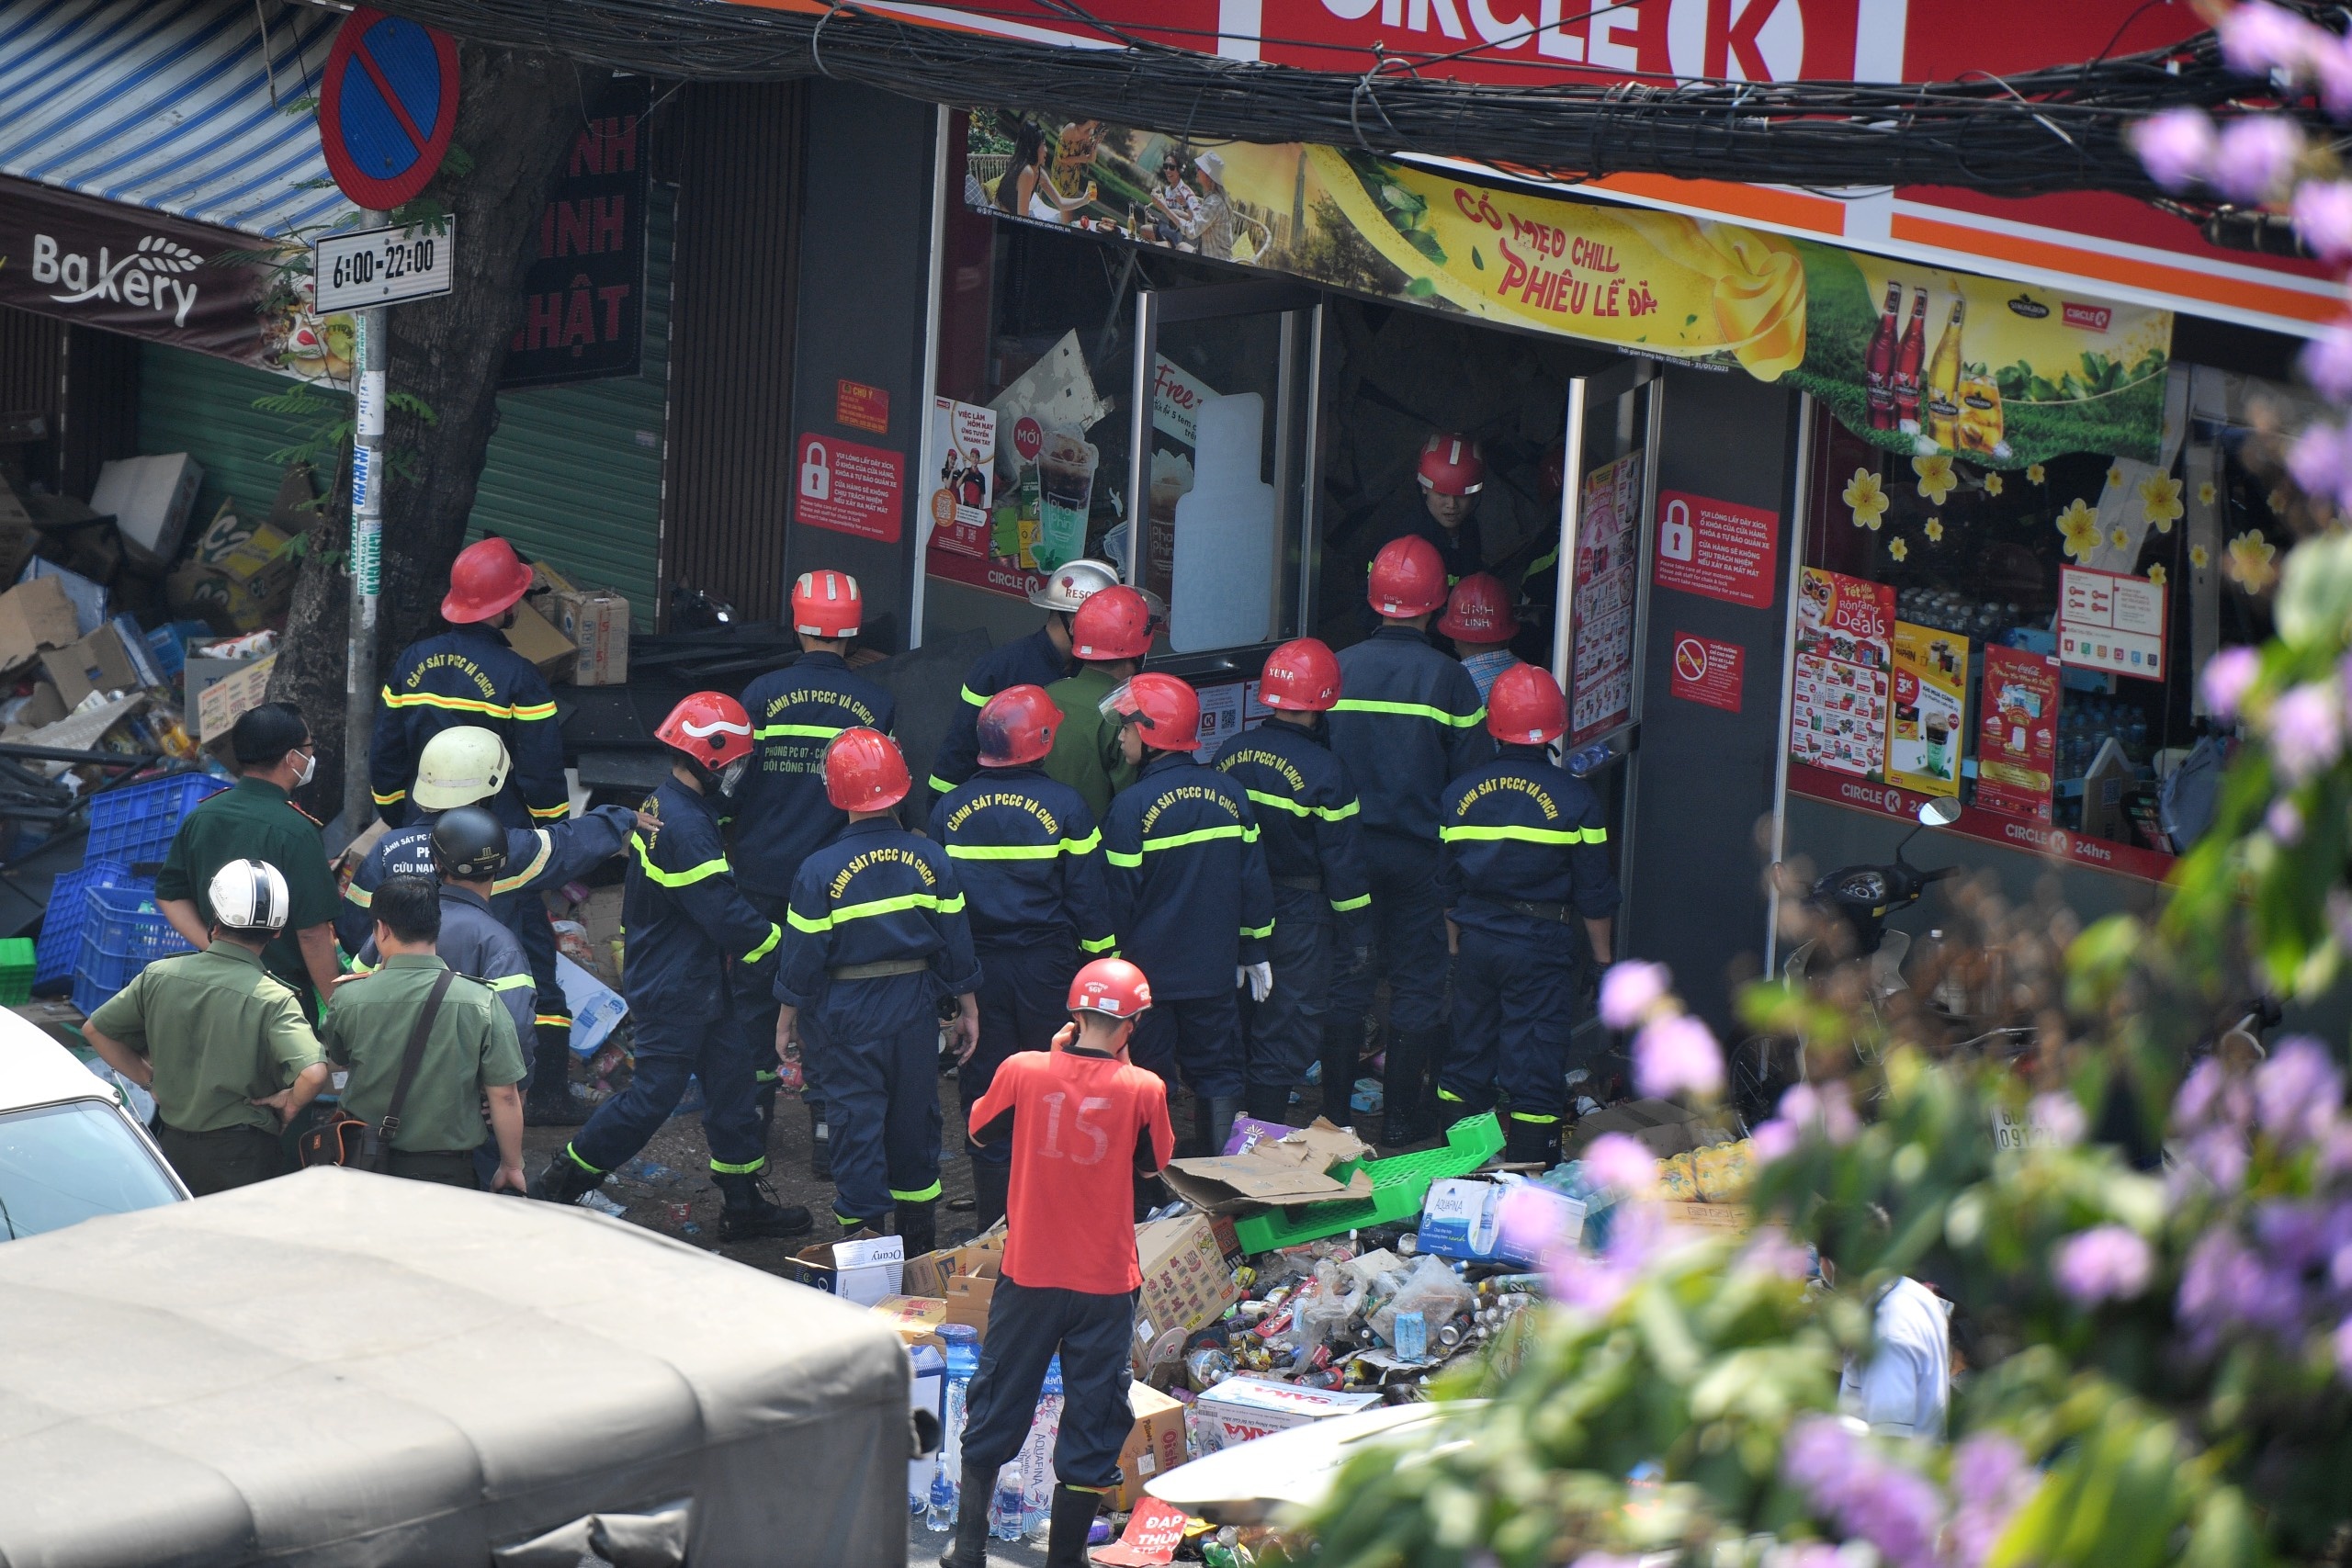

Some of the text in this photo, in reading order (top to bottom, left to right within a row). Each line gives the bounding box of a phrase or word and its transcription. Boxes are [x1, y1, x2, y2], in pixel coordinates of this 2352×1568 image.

[1509, 213, 1566, 262] MẸO
[1572, 237, 1620, 275] CHILL
[333, 239, 434, 288] 6:00-22:00
[32, 233, 198, 327] Bakery
[1497, 238, 1657, 317] PHIÊU LỄ ĐÃ
[2067, 309, 2095, 321] CIRCLE
[1694, 363, 1729, 372] 31/01/2023
[1155, 364, 1193, 410] Free
[958, 411, 985, 421] VIỆC LÀM
[967, 420, 981, 428] HÔM
[1171, 411, 1177, 419] 5
[1178, 414, 1192, 429] tem
[1016, 429, 1040, 446] MỚI
[1050, 499, 1072, 515] Pha
[1051, 513, 1071, 530] Phin
[1711, 513, 1727, 521] LÒNG
[1705, 520, 1722, 529] KHÓA
[1723, 523, 1735, 533] CỦA
[1731, 534, 1744, 543] BẢO
[1744, 537, 1761, 547] QUẢN
[1761, 541, 1770, 549] XE
[1712, 543, 1729, 553] HÀNG
[1738, 549, 1760, 559] KHÔNG
[1713, 552, 1734, 562] TRÁCH
[1724, 563, 1733, 571] RA
[1733, 565, 1746, 574] MẤT
[988, 570, 1023, 590] CIRCLE
[1844, 584, 1861, 598] Tết
[1461, 603, 1494, 615] LINH
[1839, 599, 1880, 615] Rộn ràng
[1464, 618, 1490, 627] LINH
[1837, 609, 1885, 635] Deals
[426, 653, 445, 669] SÁT
[464, 661, 480, 677] VÀ
[474, 671, 496, 699] CNCH
[766, 688, 876, 726] CẢNH SÁT PCCC VÀ CNCH
[764, 745, 808, 758] PHÒNG PC 07
[763, 761, 777, 773] ĐỘI
[779, 760, 804, 773] CÔNG
[1237, 748, 1253, 763] SÁT
[1253, 750, 1277, 767] PCCC
[1275, 757, 1286, 772] VÀ
[1283, 763, 1306, 792] CNCH
[1158, 791, 1176, 808] SÁT
[1176, 785, 1202, 802] PCCC
[1204, 787, 1216, 802] VÀ
[1456, 776, 1559, 820] CẢNH SÁT PCCC VÀ CNCH
[1841, 783, 1883, 805] CIRCLE
[947, 793, 1058, 835] CẢNH SÁT PCCC VÀ CNCH
[401, 834, 415, 845] SÁT
[2005, 823, 2047, 846] CIRCLE
[2075, 840, 2111, 861] 24hrs
[392, 861, 413, 874] CỨU
[830, 848, 936, 899] CẢNH SÁT PCCC VÀ CNCH
[1037, 1091, 1113, 1165] 15
[1434, 1198, 1464, 1214] AQUAFINA
[872, 1249, 901, 1261] Ocany
[1031, 1433, 1046, 1489] AQUAFINA
[1146, 1516, 1183, 1531] ĐẠP
